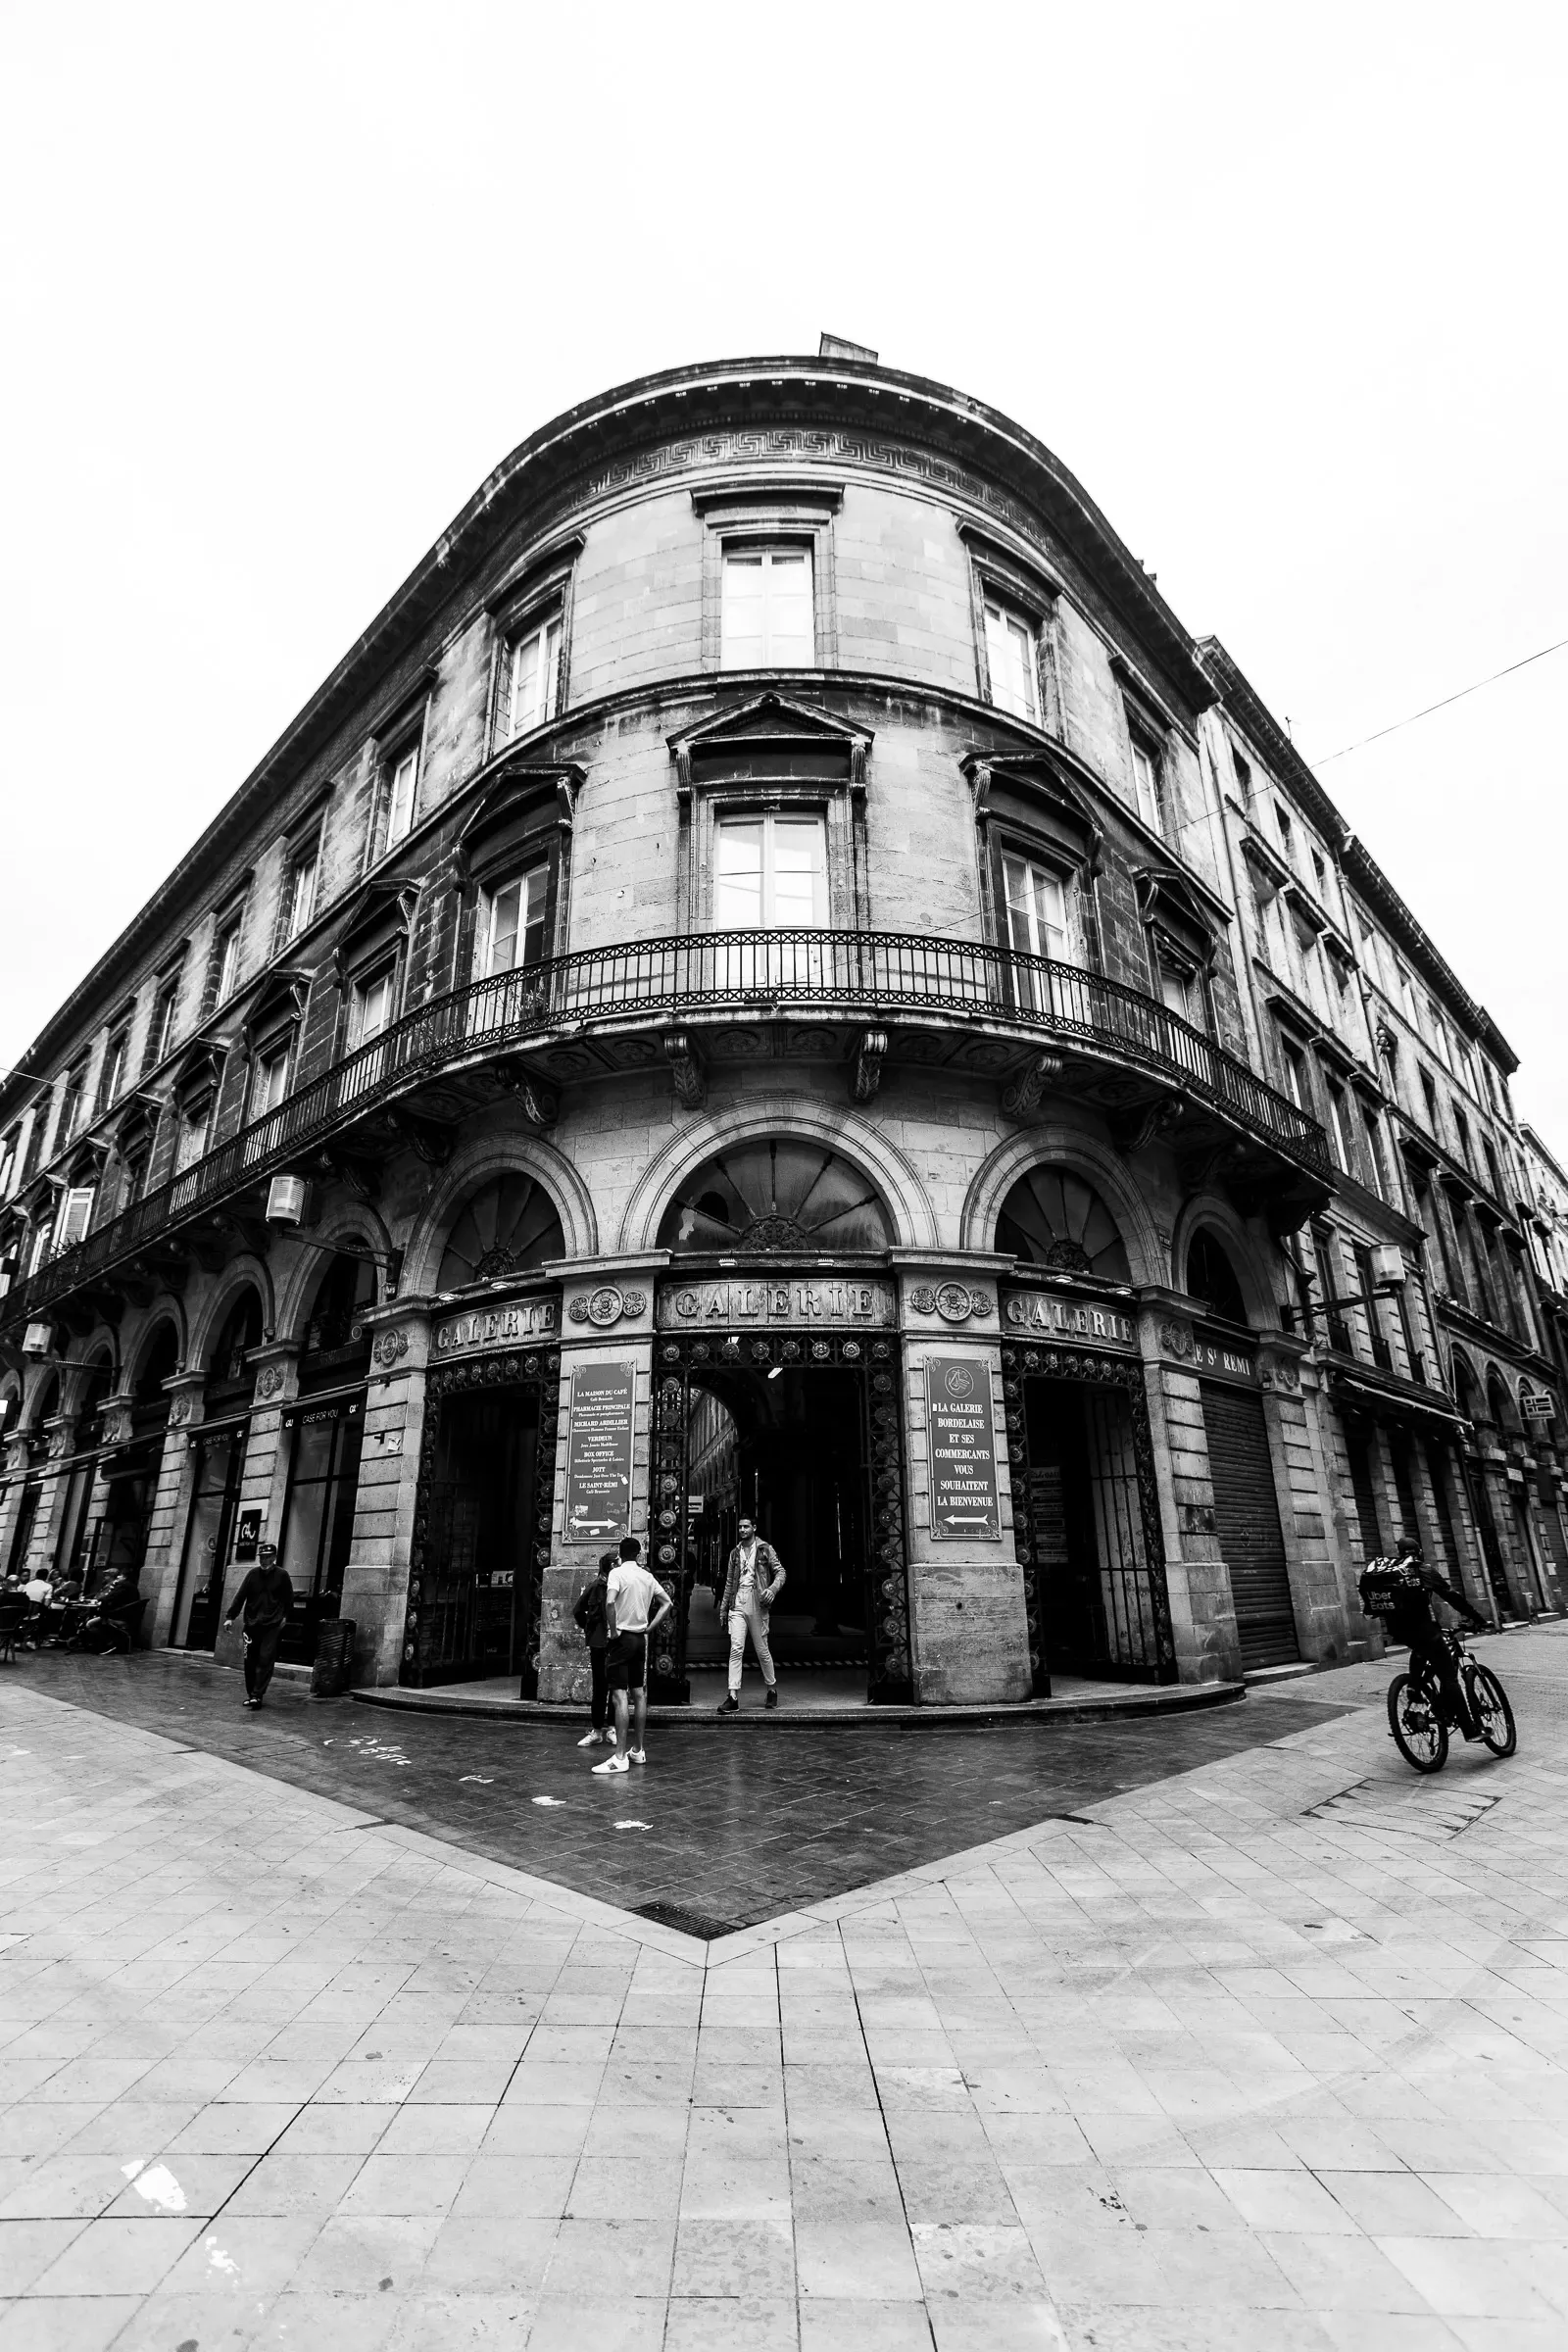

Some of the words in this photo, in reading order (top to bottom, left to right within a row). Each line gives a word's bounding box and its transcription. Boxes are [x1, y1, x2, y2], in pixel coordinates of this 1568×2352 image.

[676, 1288, 873, 1316] GALERIE
[438, 1303, 556, 1349] GALERIE
[1006, 1299, 1133, 1343] GALERIE
[1223, 1352, 1250, 1376] REMI
[938, 1403, 948, 1412] LA
[950, 1403, 983, 1414] GALERIE
[302, 1413, 316, 1424] CASE
[316, 1411, 328, 1421] FOR
[327, 1409, 339, 1419] YOU
[938, 1418, 985, 1429] BORDELAISE
[949, 1434, 959, 1444] ET
[960, 1434, 975, 1444] SES
[954, 1465, 974, 1475] VOUS
[940, 1481, 989, 1491] SOUHAITENT
[937, 1495, 949, 1506] LA
[950, 1496, 993, 1506] BIENVENUE
[1367, 1592, 1392, 1600] Uber
[1369, 1600, 1396, 1610] Eats
